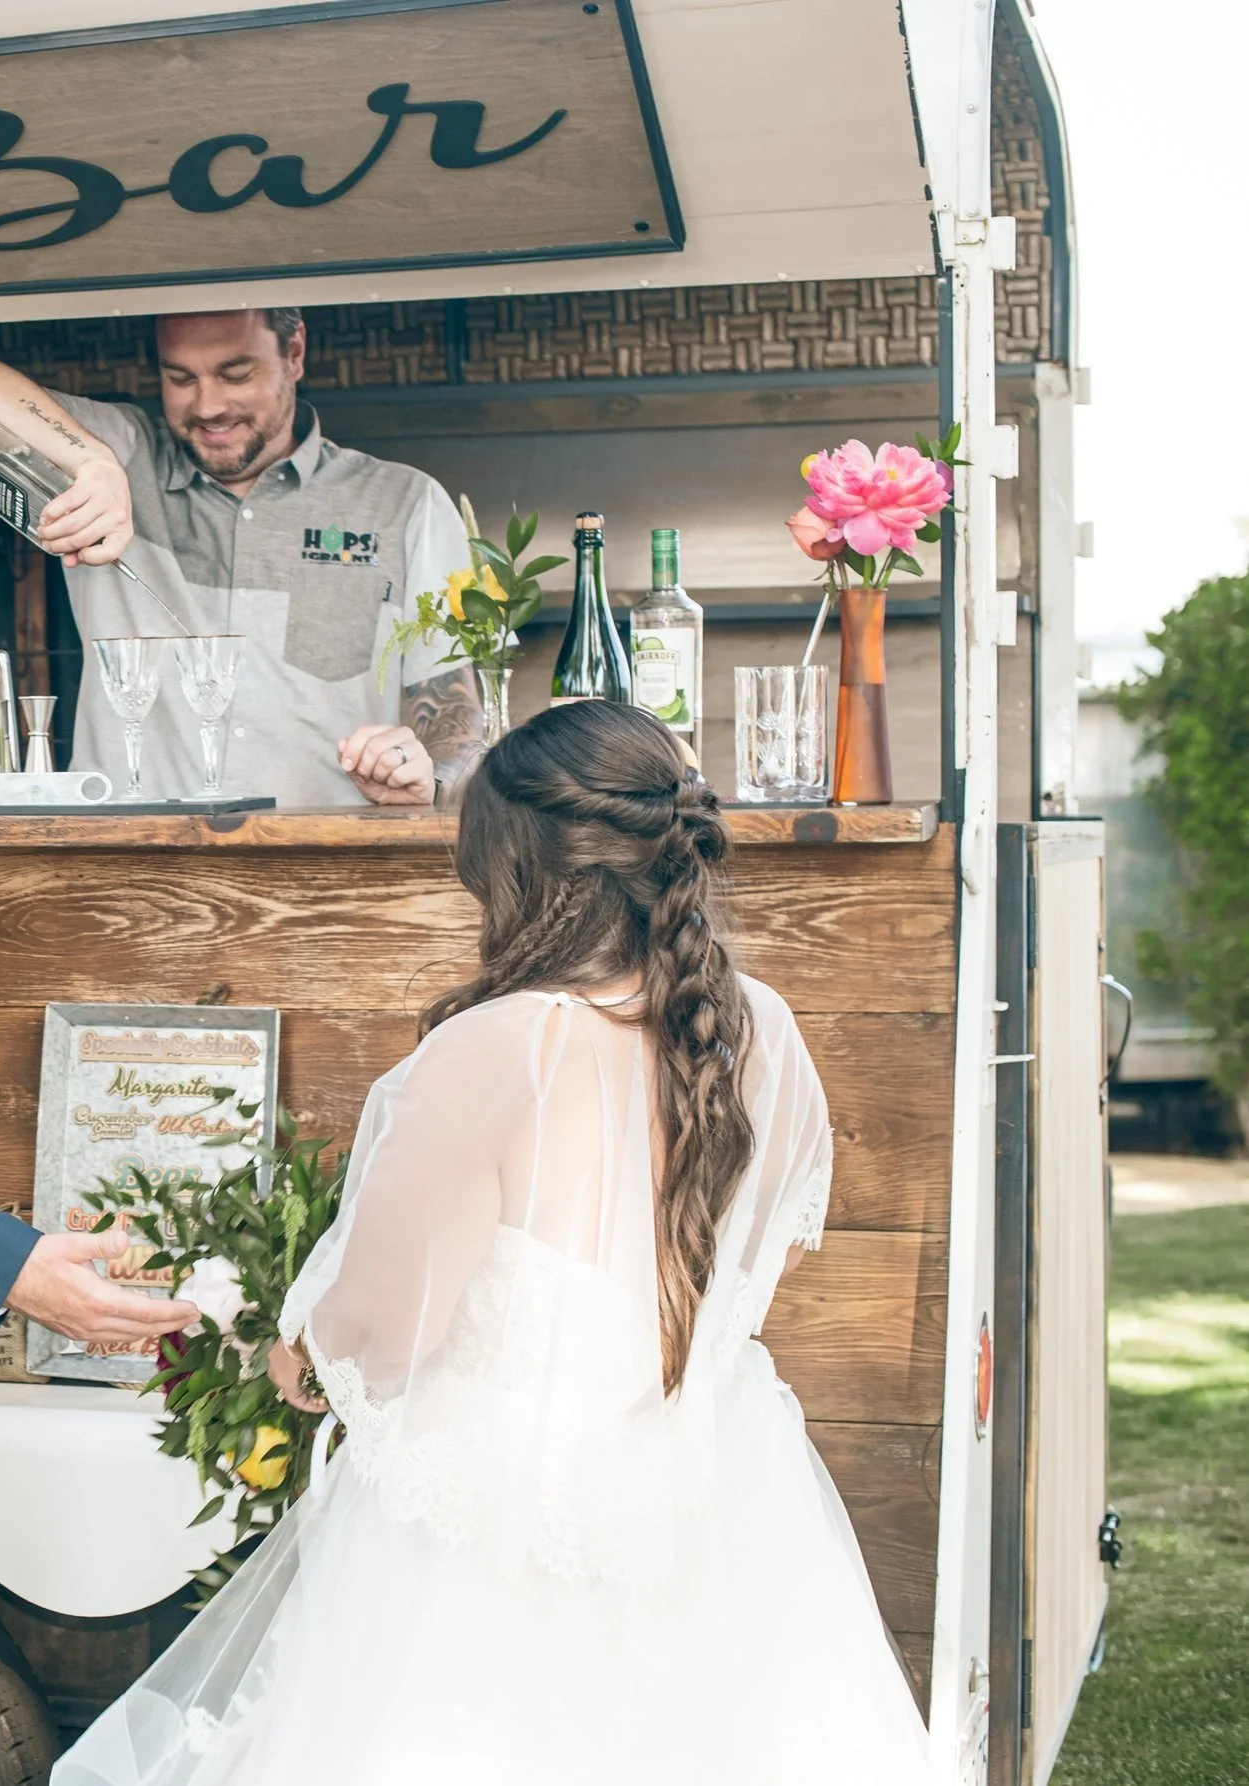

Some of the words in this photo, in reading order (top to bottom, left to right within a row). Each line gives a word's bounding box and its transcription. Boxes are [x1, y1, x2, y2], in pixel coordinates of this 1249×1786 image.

[636, 651, 676, 661] SMIRNOFF
[108, 1067, 214, 1105] Margarita
[156, 1115, 188, 1134] Old
[113, 1154, 202, 1190] Beer
[67, 1207, 113, 1232] Cra
